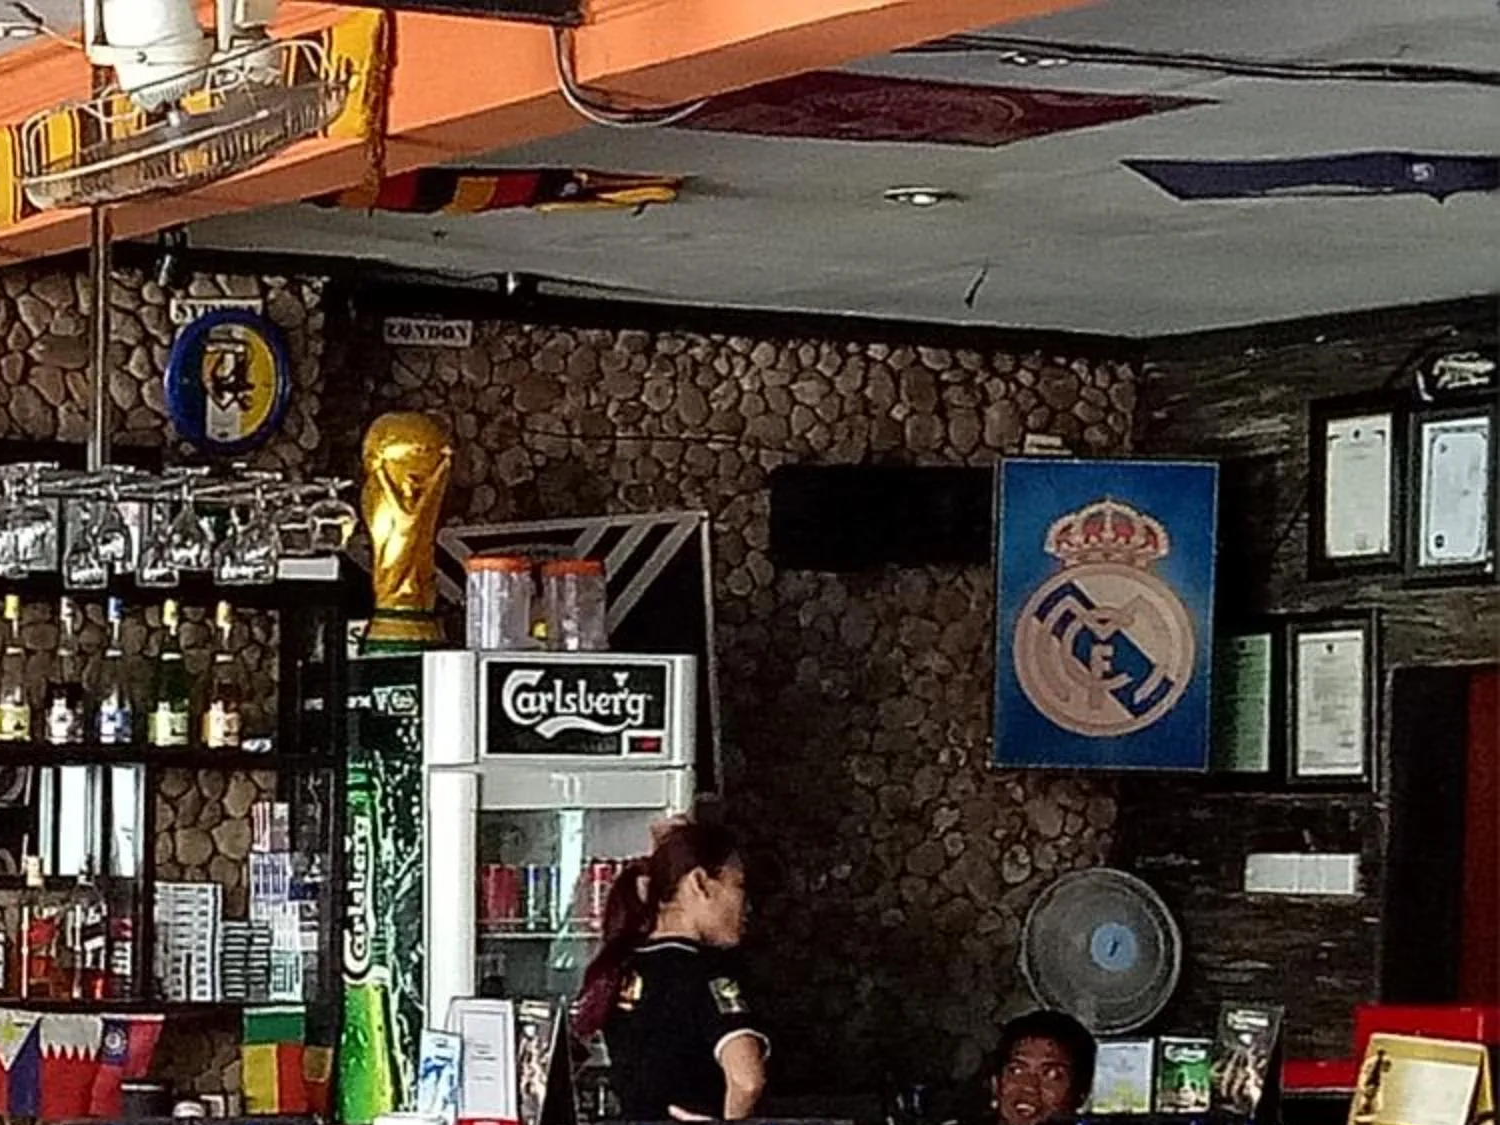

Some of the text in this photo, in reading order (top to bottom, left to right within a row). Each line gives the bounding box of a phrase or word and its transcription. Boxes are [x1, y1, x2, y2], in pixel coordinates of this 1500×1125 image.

[387, 323, 467, 340] LONDON
[502, 669, 647, 738] Carlsberg
[344, 815, 374, 974] Carlsberg
